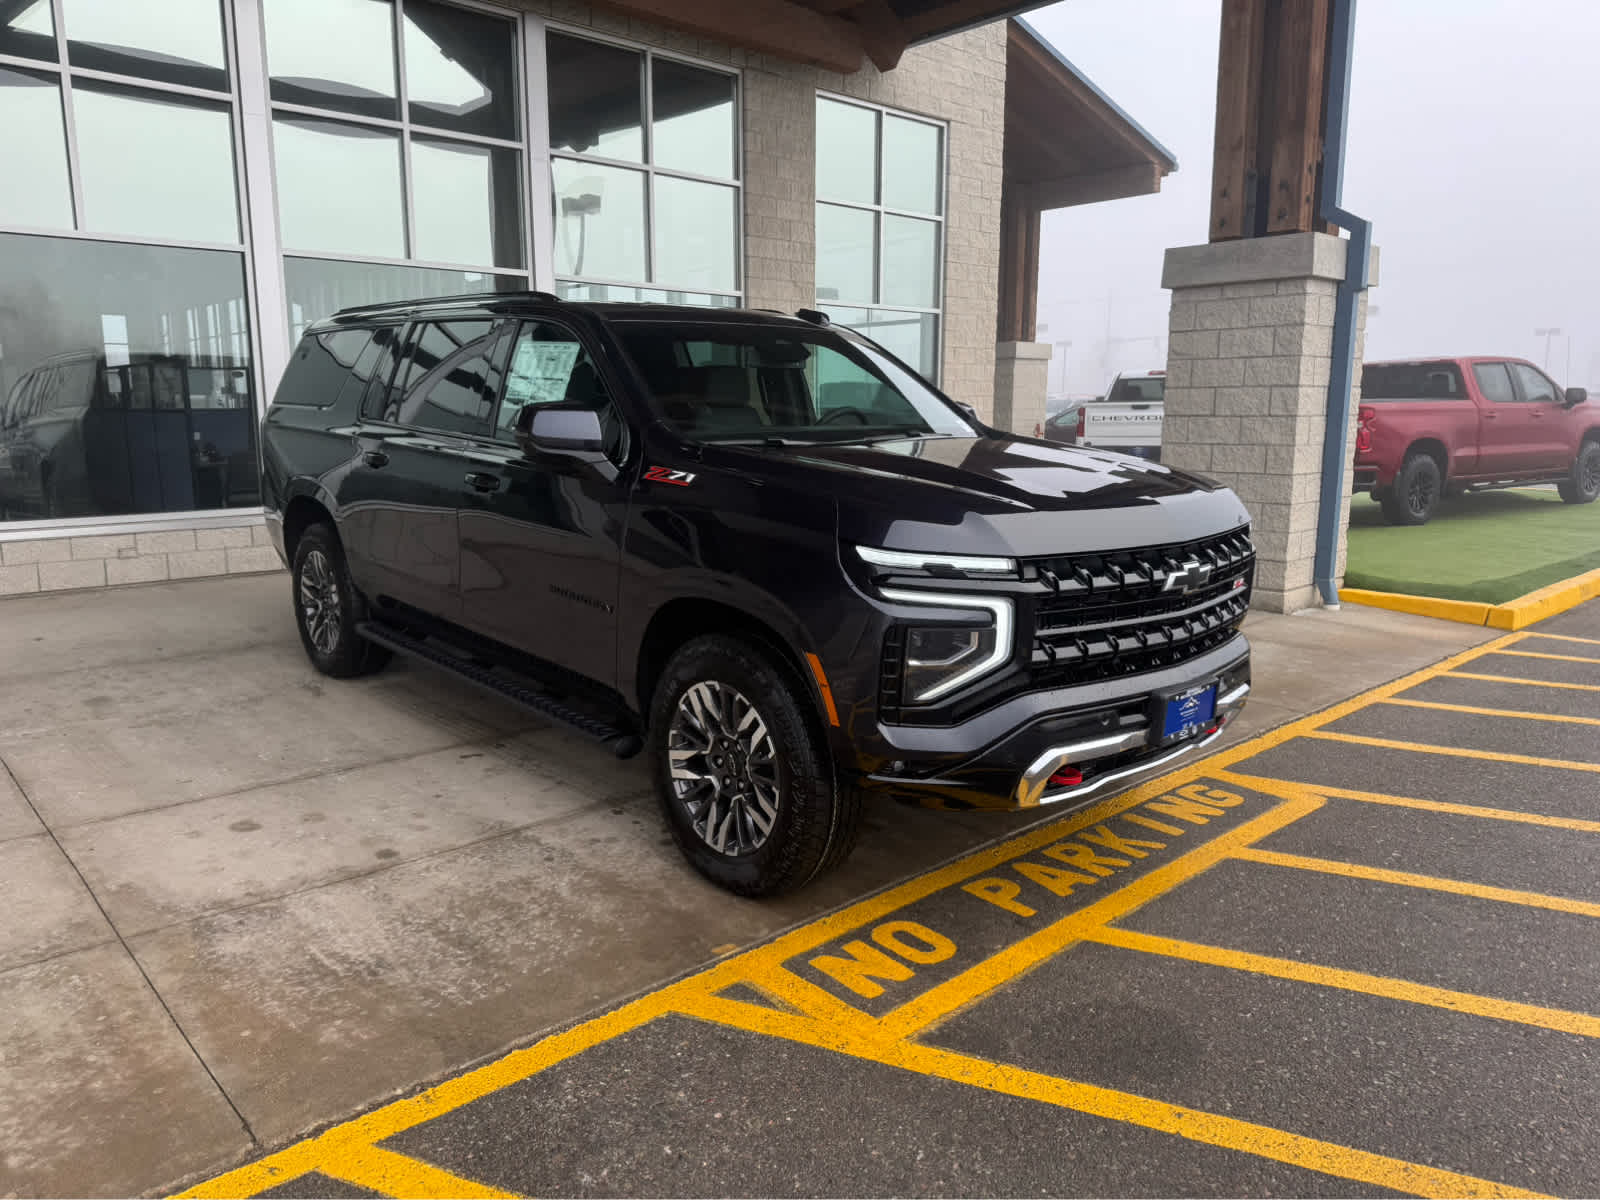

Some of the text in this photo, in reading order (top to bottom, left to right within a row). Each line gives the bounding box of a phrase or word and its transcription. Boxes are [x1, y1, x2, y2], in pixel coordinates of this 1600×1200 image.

[644, 465, 696, 487] Z71
[808, 783, 1245, 1000] NO PARKING
